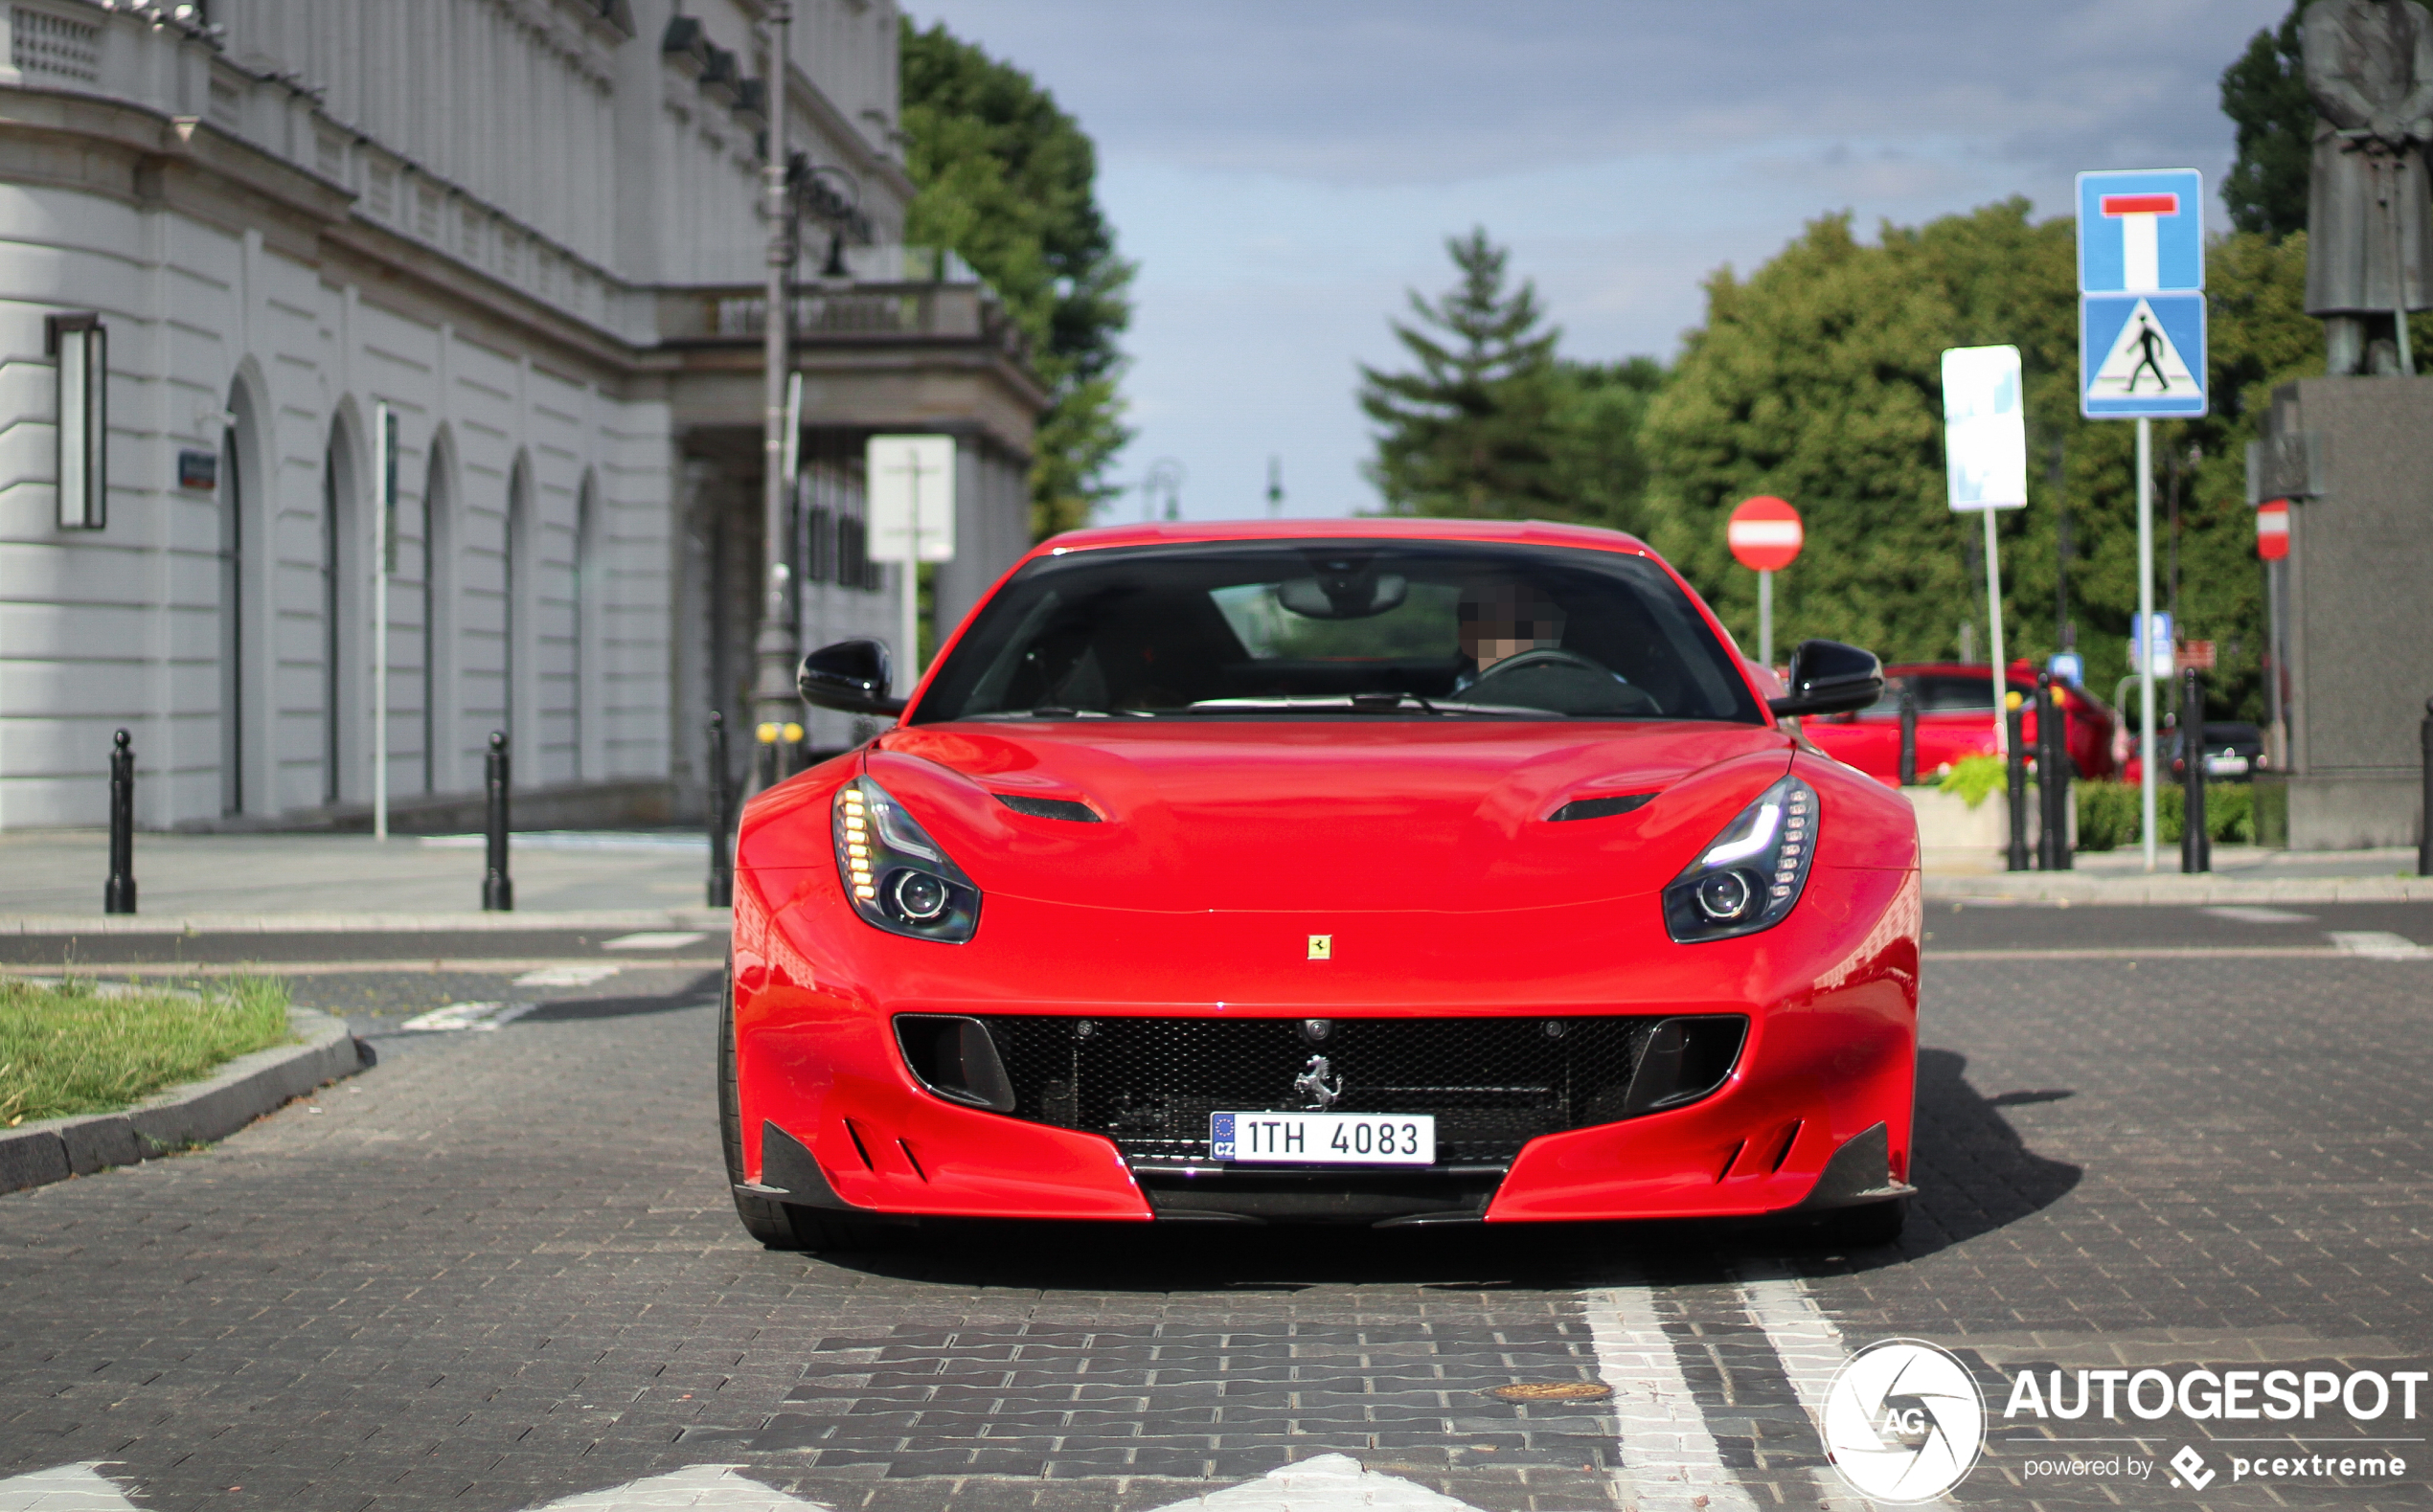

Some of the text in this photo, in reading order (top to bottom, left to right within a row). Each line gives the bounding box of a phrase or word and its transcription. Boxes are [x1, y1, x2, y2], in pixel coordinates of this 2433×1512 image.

[1214, 1141, 1235, 1156] CZ
[1248, 1121, 1418, 1155] 1TH 4083
